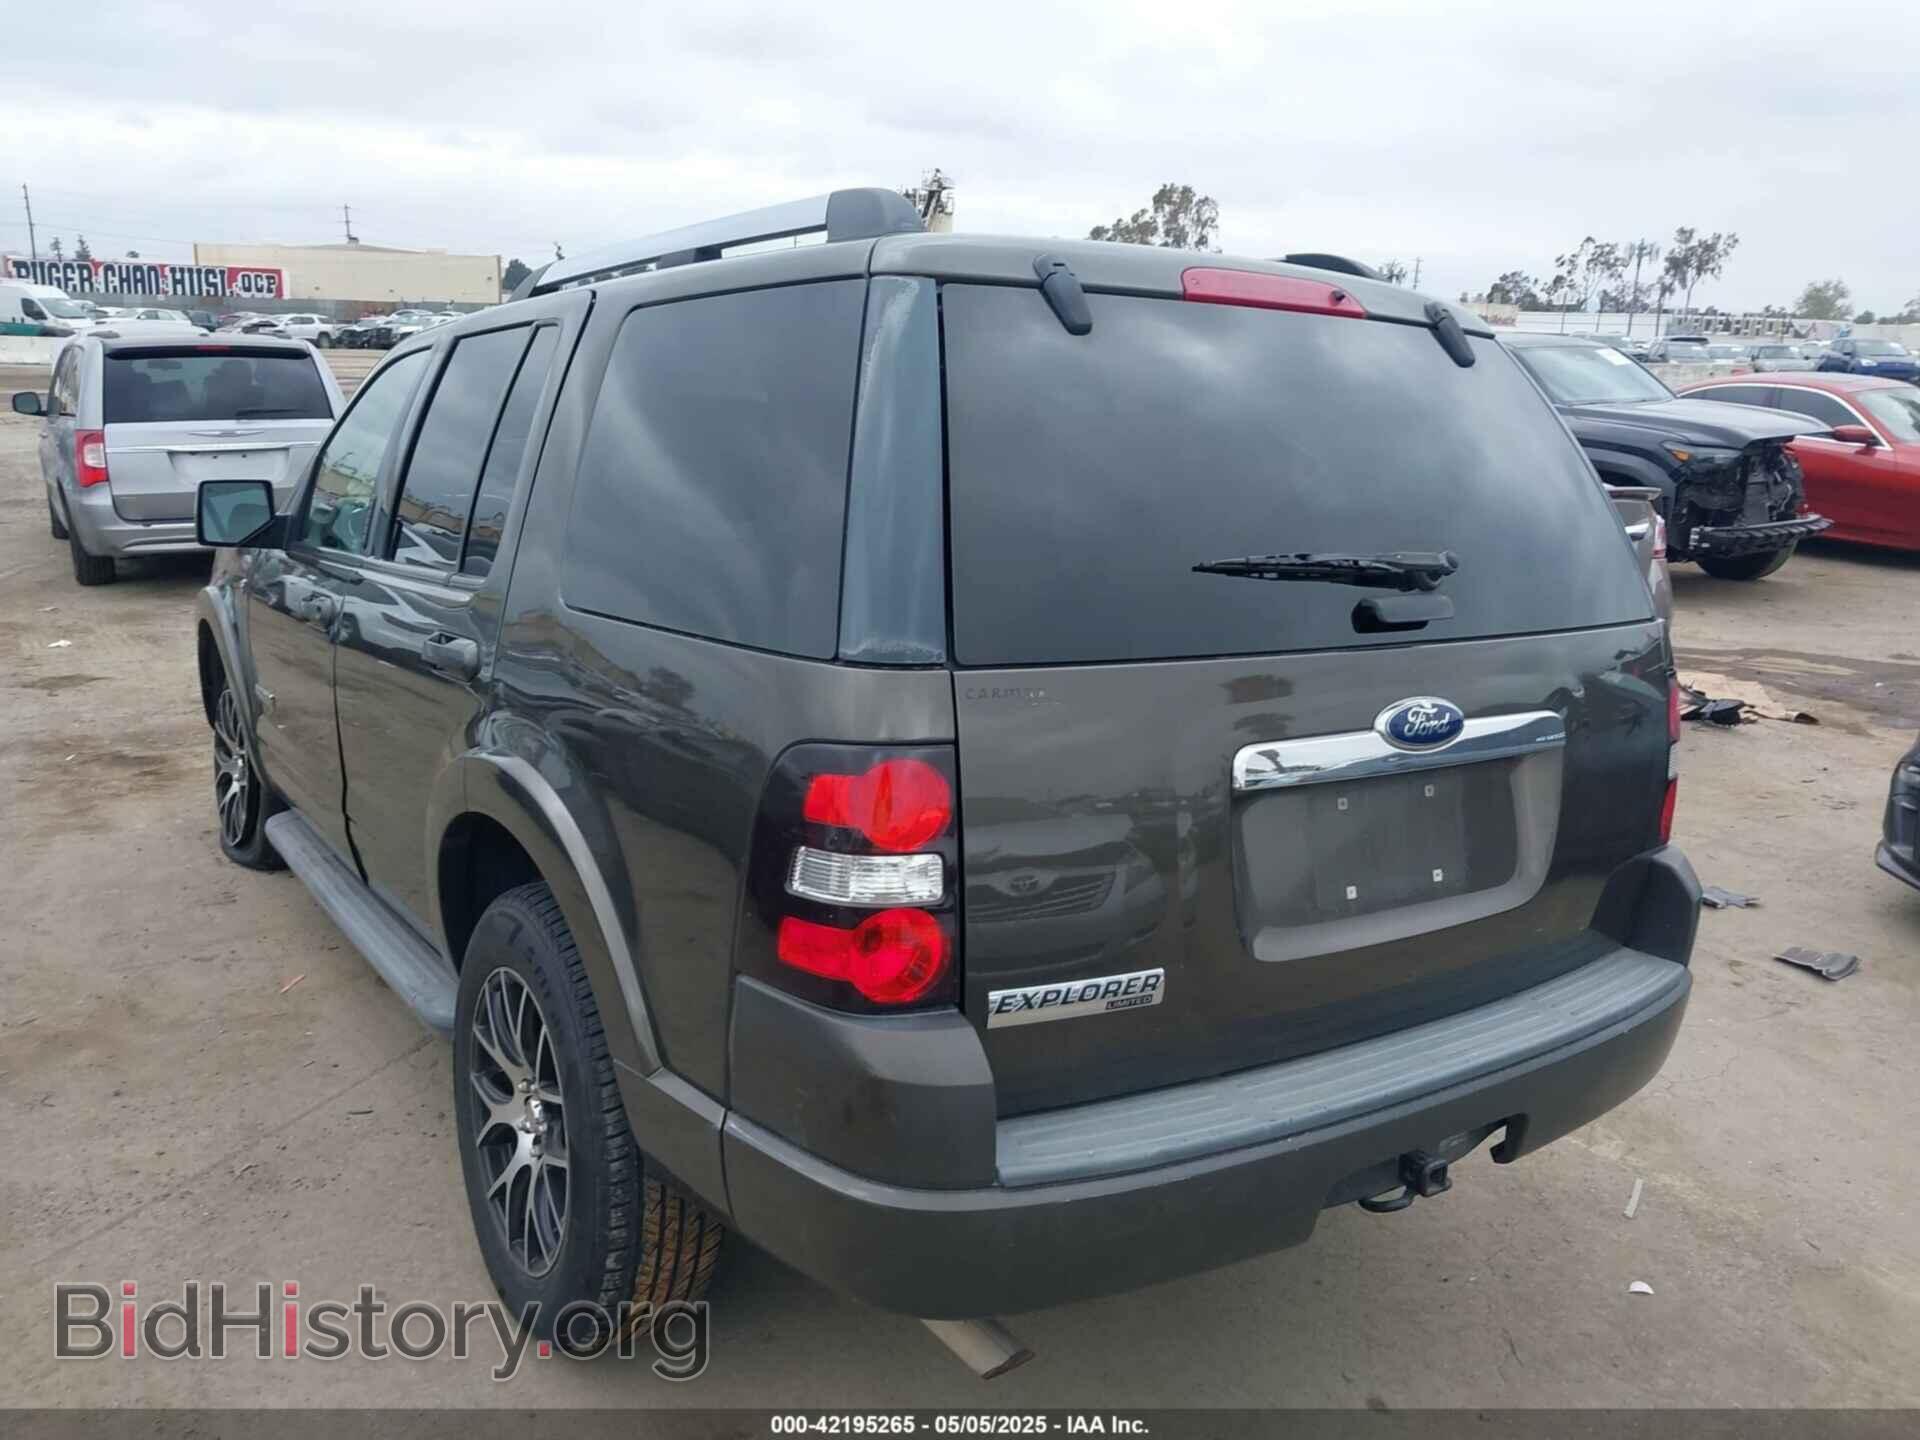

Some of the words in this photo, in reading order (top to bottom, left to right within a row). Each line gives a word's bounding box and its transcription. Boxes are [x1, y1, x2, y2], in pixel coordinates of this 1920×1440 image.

[1404, 706, 1451, 737] Ford
[994, 974, 1162, 1015] EXPLORER
[1105, 994, 1153, 1010] LIMITED
